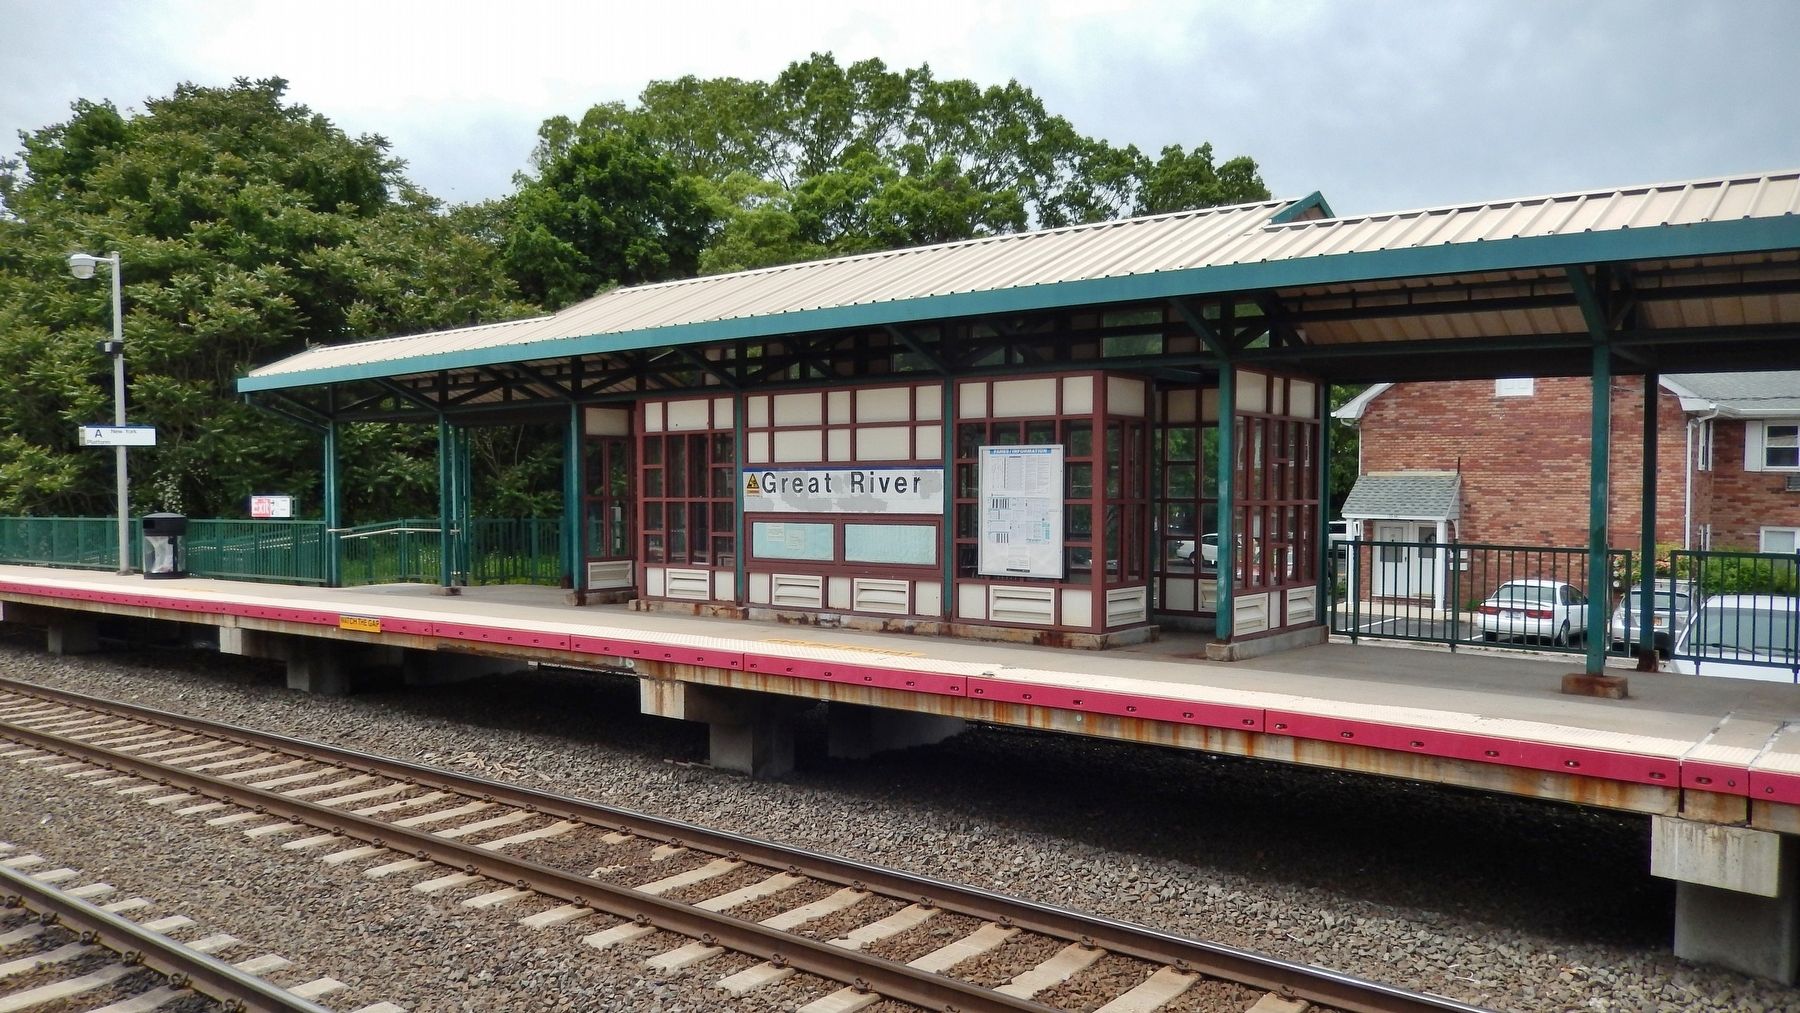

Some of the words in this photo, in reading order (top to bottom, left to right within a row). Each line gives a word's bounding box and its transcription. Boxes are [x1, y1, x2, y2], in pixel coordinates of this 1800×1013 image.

[95, 429, 102, 438] A
[762, 472, 832, 494] Great
[850, 471, 922, 494] River
